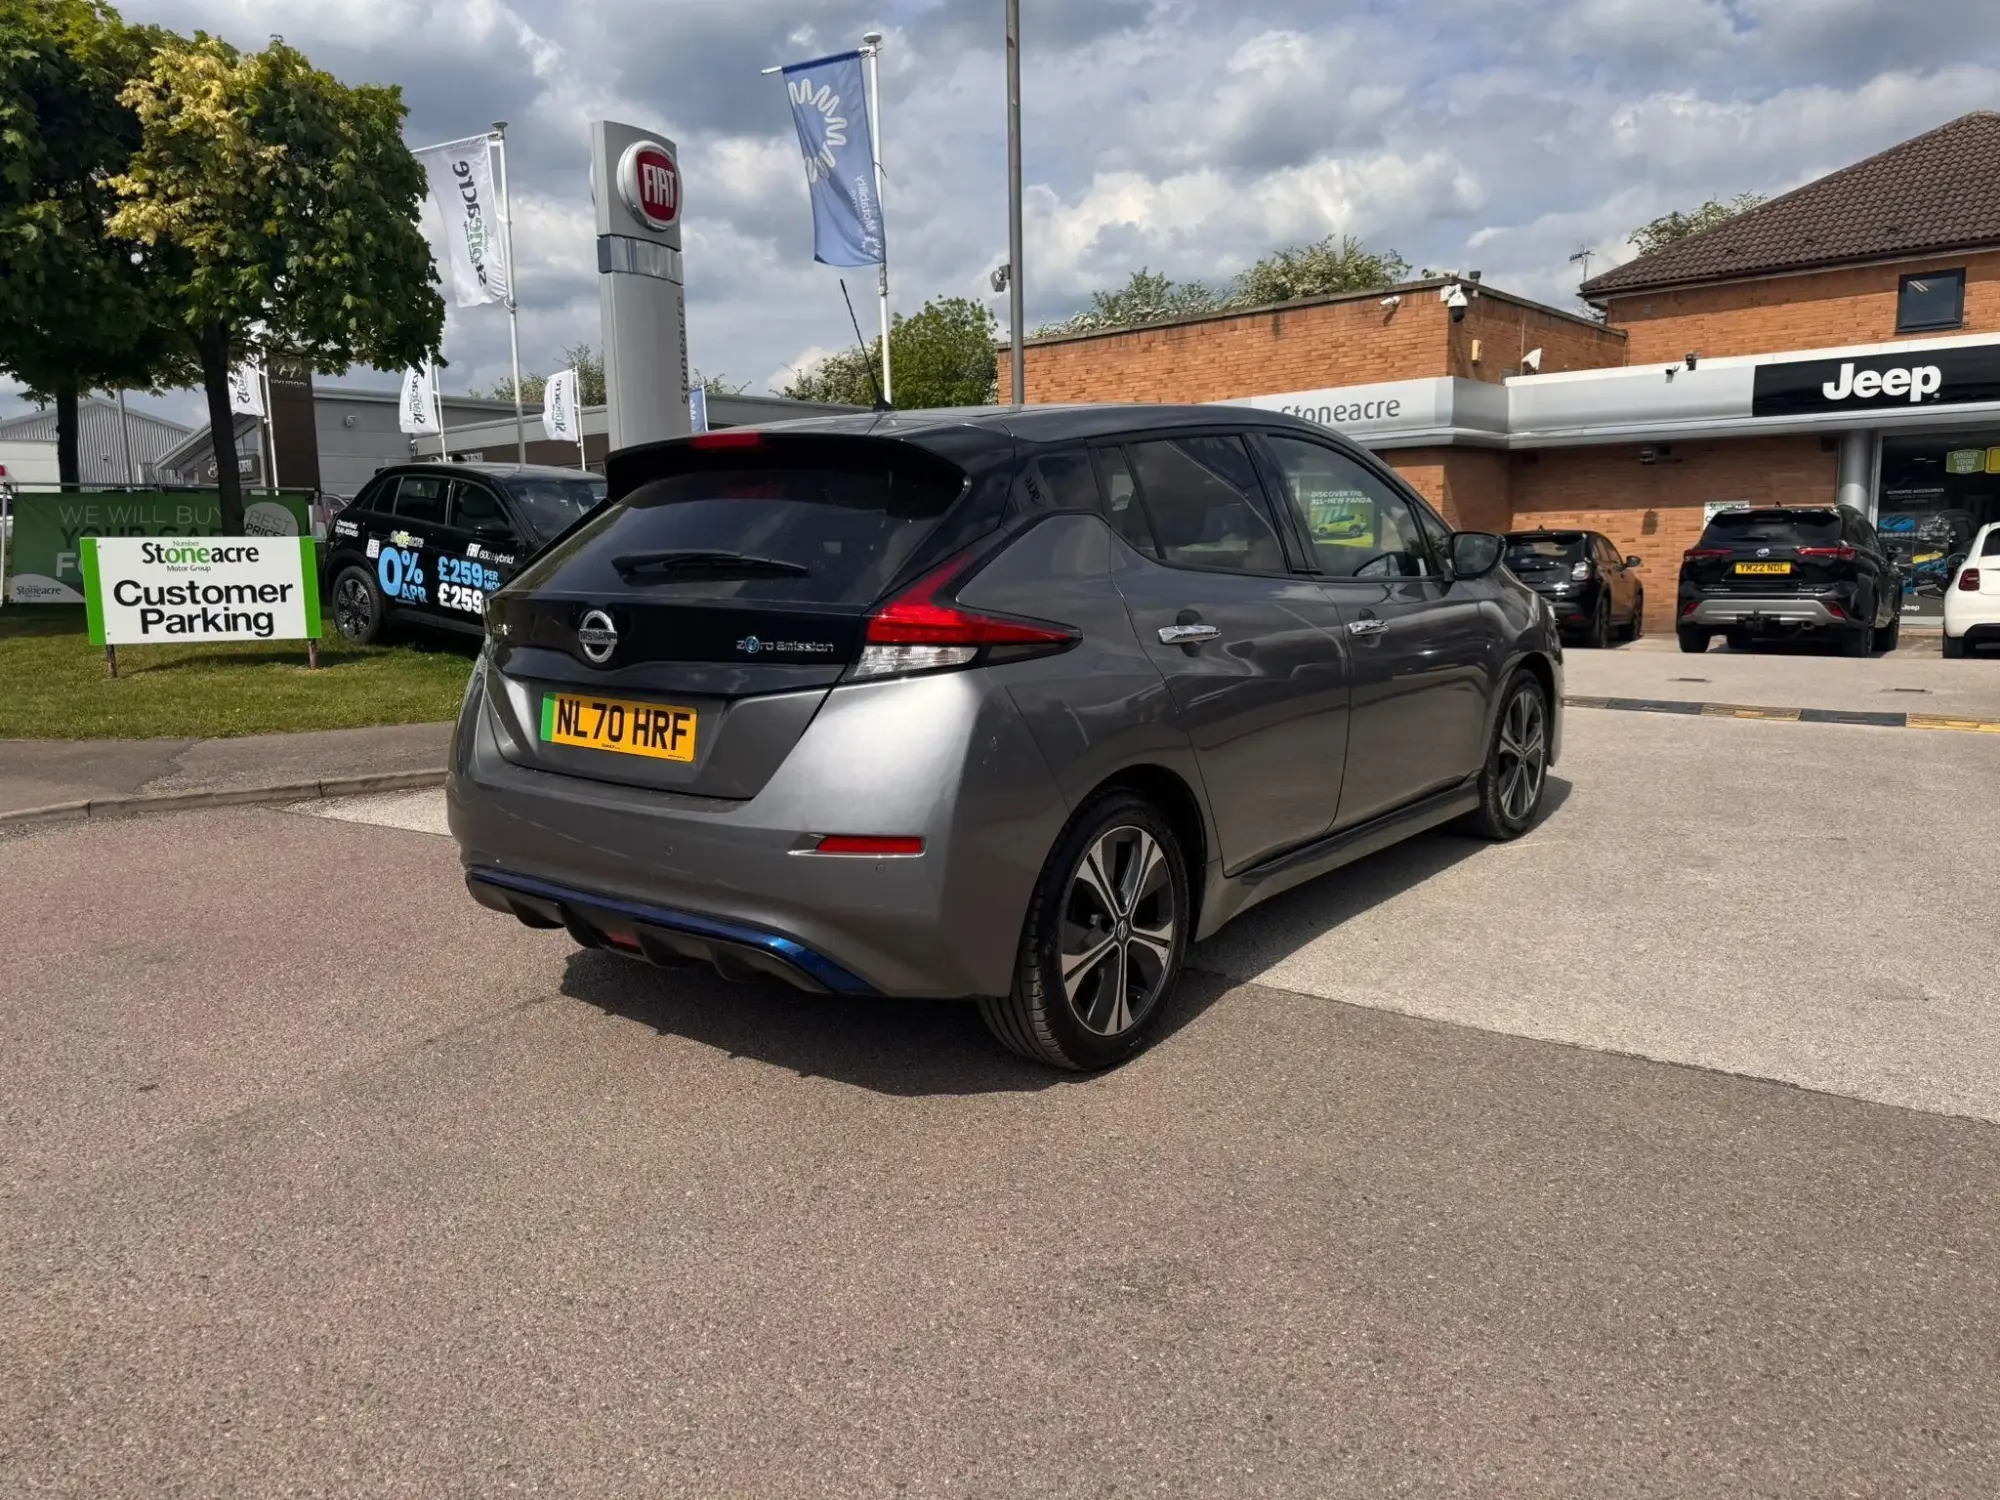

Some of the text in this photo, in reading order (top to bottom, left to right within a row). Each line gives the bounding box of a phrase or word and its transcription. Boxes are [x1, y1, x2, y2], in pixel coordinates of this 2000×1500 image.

[642, 163, 676, 209] FIAT
[1823, 362, 1942, 402] Jeep
[58, 505, 99, 524] WE
[108, 505, 167, 524] WILL
[249, 509, 293, 533] BEST
[141, 542, 259, 564] Stoneacre
[491, 552, 515, 564] Hybrid
[190, 564, 212, 573] Group
[378, 547, 424, 596] 0%
[437, 556, 499, 588] £259 PER
[16, 585, 62, 595] Stoneacre
[113, 579, 294, 607] Customer
[401, 582, 428, 604] APR
[437, 582, 484, 615] £259
[140, 606, 275, 637] Parking
[556, 698, 690, 751] NL70 HRF
